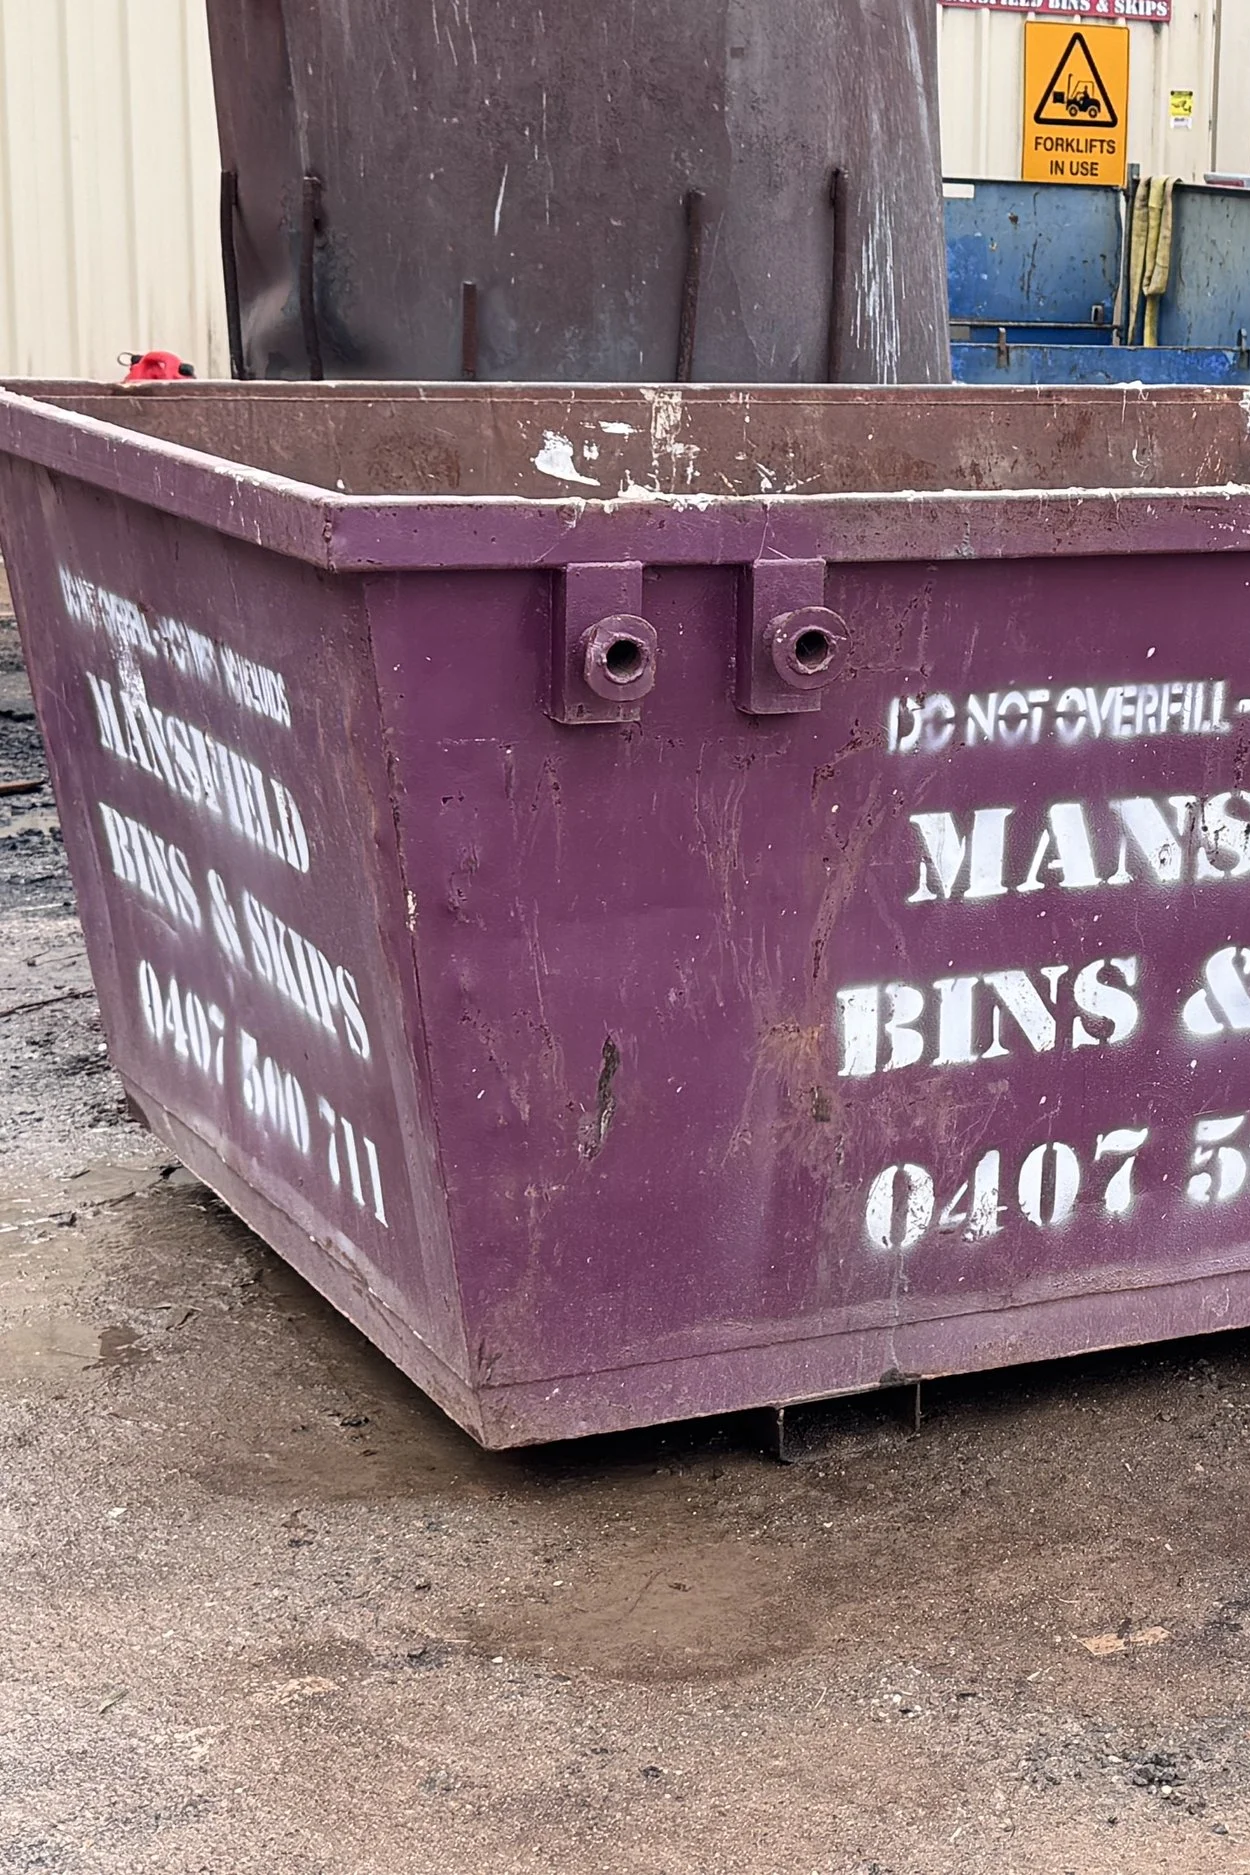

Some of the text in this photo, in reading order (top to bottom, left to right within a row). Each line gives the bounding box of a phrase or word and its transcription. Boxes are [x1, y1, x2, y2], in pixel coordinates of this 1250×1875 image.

[1114, 0, 1168, 16] SKIPS
[1034, 136, 1117, 154] FORKLIFTS
[1050, 160, 1099, 176] IN USE
[86, 671, 310, 873] MANSFIELD
[889, 691, 956, 754] DO
[967, 687, 1051, 747] NOT
[1056, 680, 1233, 743] OVERFILL
[98, 802, 371, 1059] BINS & SKIPS
[836, 957, 1141, 1078] BINS
[138, 959, 389, 1229] 0407 500 711
[863, 1127, 1150, 1251] 0407
